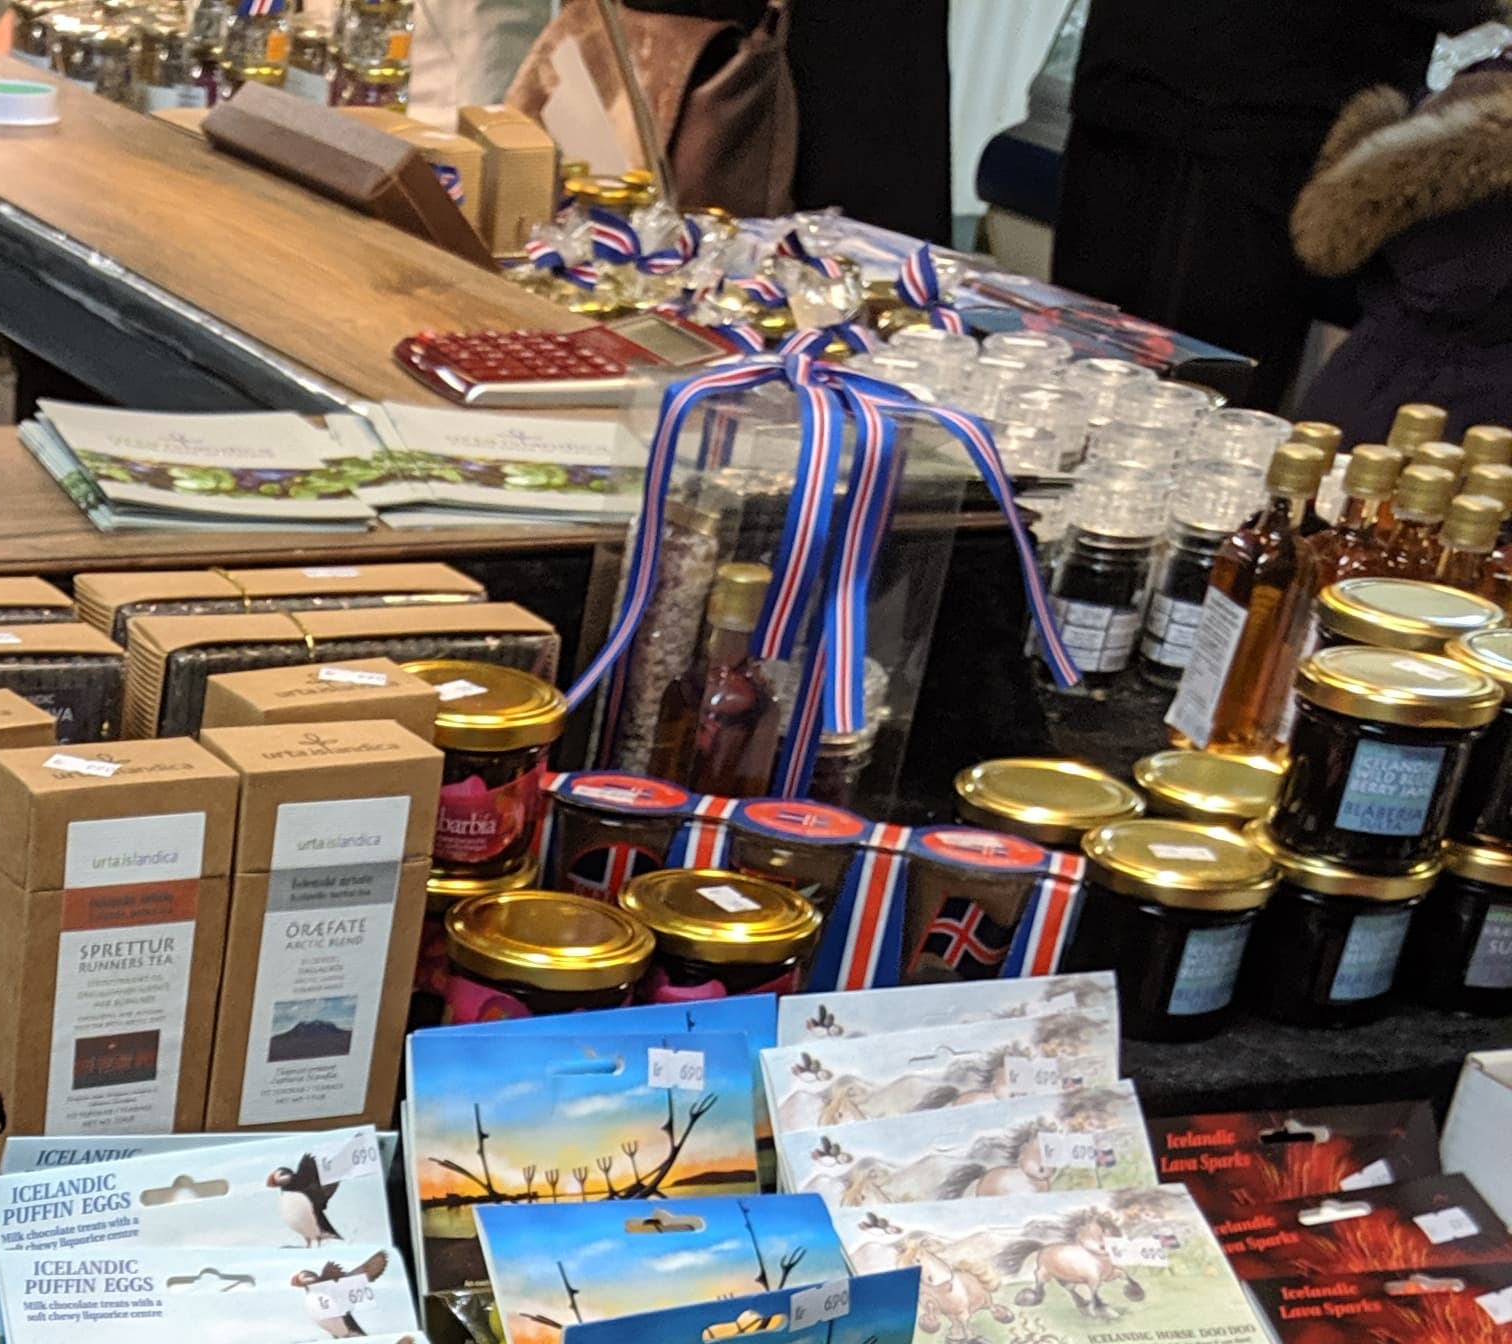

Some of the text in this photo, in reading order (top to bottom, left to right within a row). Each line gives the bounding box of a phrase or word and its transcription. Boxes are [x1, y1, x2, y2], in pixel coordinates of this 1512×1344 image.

[297, 833, 382, 851] urta.islandica
[92, 851, 178, 869] urta.islandica
[80, 937, 175, 960] SPRETTUR
[285, 934, 363, 951] ARCTIC BLEND
[78, 955, 173, 973] RUNNERS TEA
[680, 1066, 702, 1081] 690
[1166, 1130, 1235, 1149] Icelandic
[36, 1149, 142, 1166] ICELANDIC
[352, 1148, 377, 1165] 690
[1161, 1153, 1250, 1173] Lava Sparks
[12, 1173, 116, 1204] ICELANDIC
[2, 1192, 131, 1226] PUFFIN EGGS
[1, 1232, 24, 1244] Milk
[26, 1225, 75, 1240] chocolate
[77, 1220, 106, 1232] treats
[109, 1216, 131, 1227] with
[1213, 1216, 1277, 1235] celandic
[60, 1233, 105, 1248] liquorice
[107, 1229, 140, 1240] centre
[1246, 1231, 1299, 1251] Sparks
[34, 1259, 138, 1275] ICELANDIC
[24, 1277, 154, 1294] PUFFIN EGGS
[348, 1287, 374, 1302] 690
[1282, 1283, 1358, 1300] Icelandic
[24, 1301, 47, 1310] Milk
[49, 1299, 98, 1310] chocolate
[100, 1299, 129, 1308] treats
[131, 1298, 154, 1307] with
[824, 1290, 847, 1309] 690
[27, 1309, 162, 1321] soft chewy liquorice centre
[1280, 1301, 1382, 1319] Lava Sparks
[1089, 1331, 1154, 1344] ICELANDIC
[1155, 1330, 1197, 1340] HORSE
[1199, 1327, 1226, 1337] DOO
[1230, 1325, 1255, 1334] DOO
